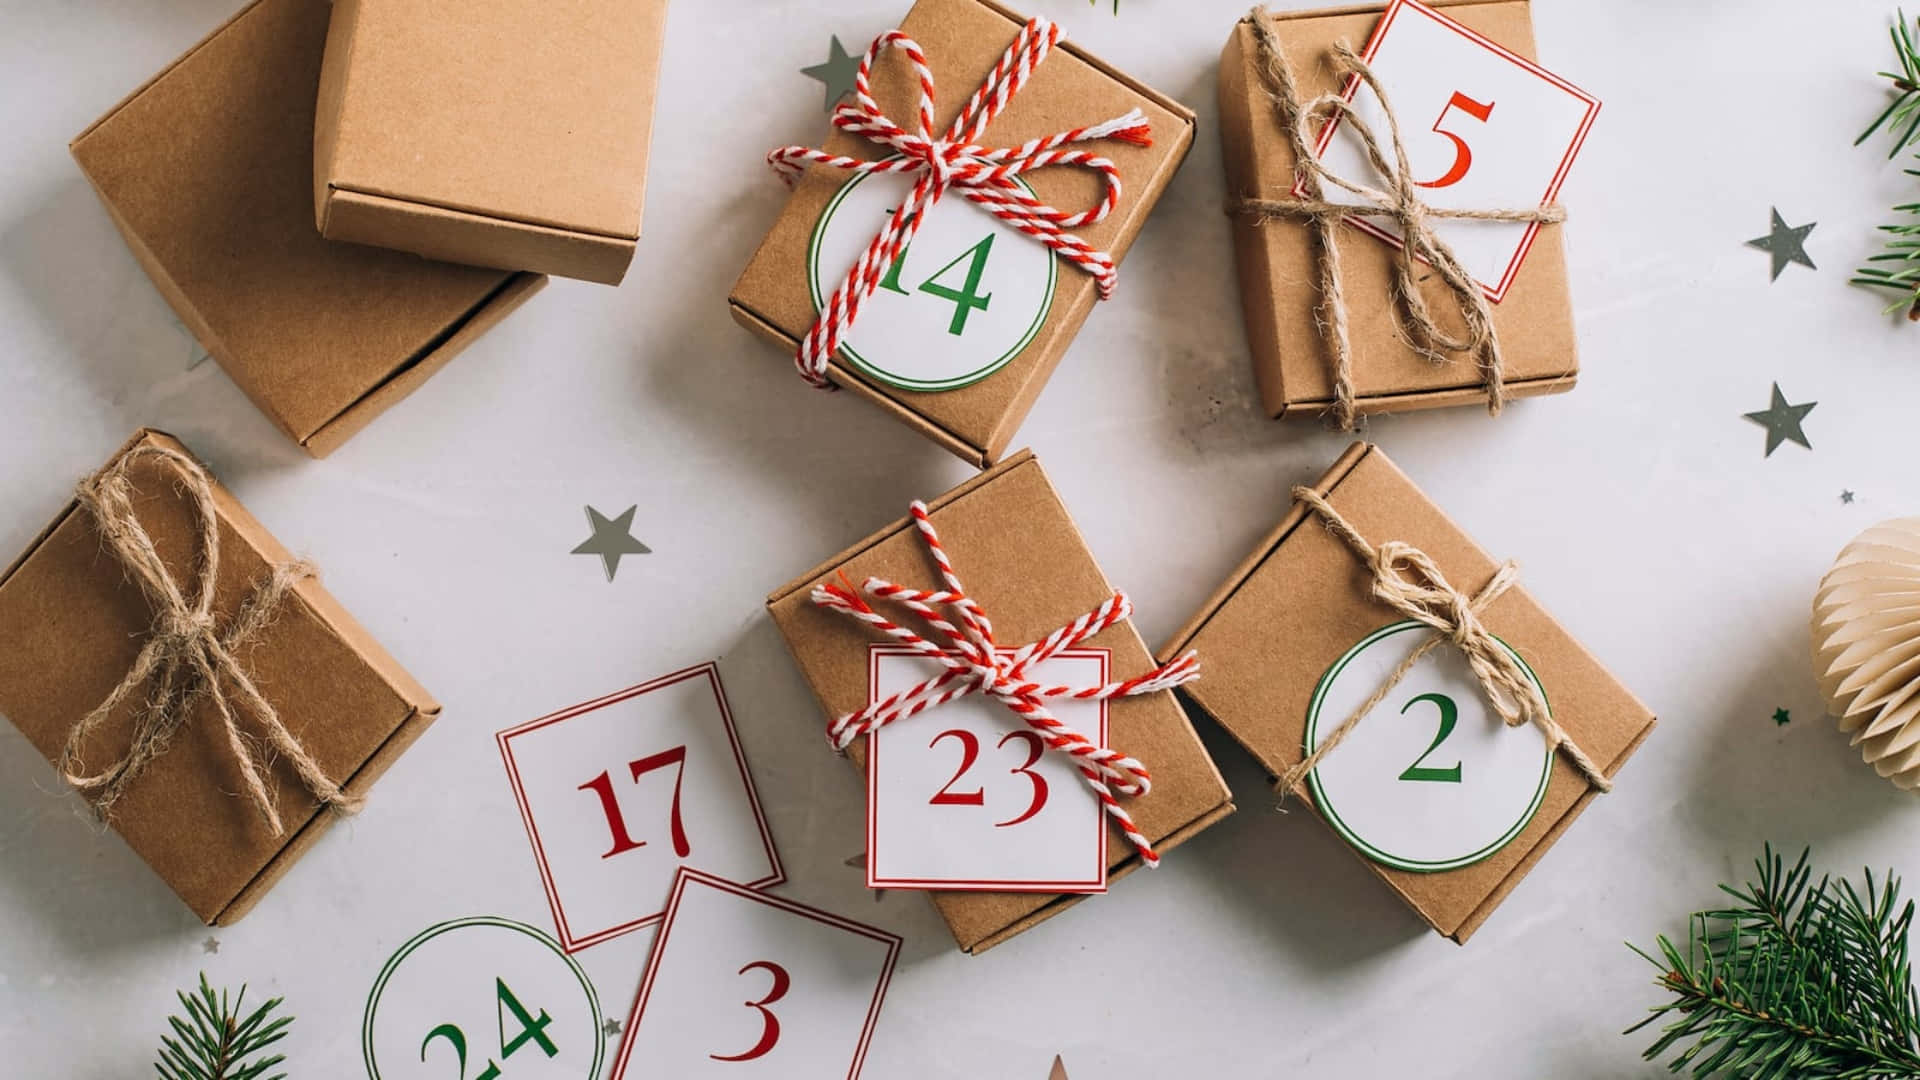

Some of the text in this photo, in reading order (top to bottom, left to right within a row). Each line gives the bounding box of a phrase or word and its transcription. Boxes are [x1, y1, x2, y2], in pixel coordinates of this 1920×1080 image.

[1412, 90, 1496, 189] 5
[928, 728, 1050, 828] 23
[1398, 693, 1463, 783] 2
[577, 744, 692, 860] 17
[421, 976, 560, 1080] 24
[709, 960, 791, 1063] 3
